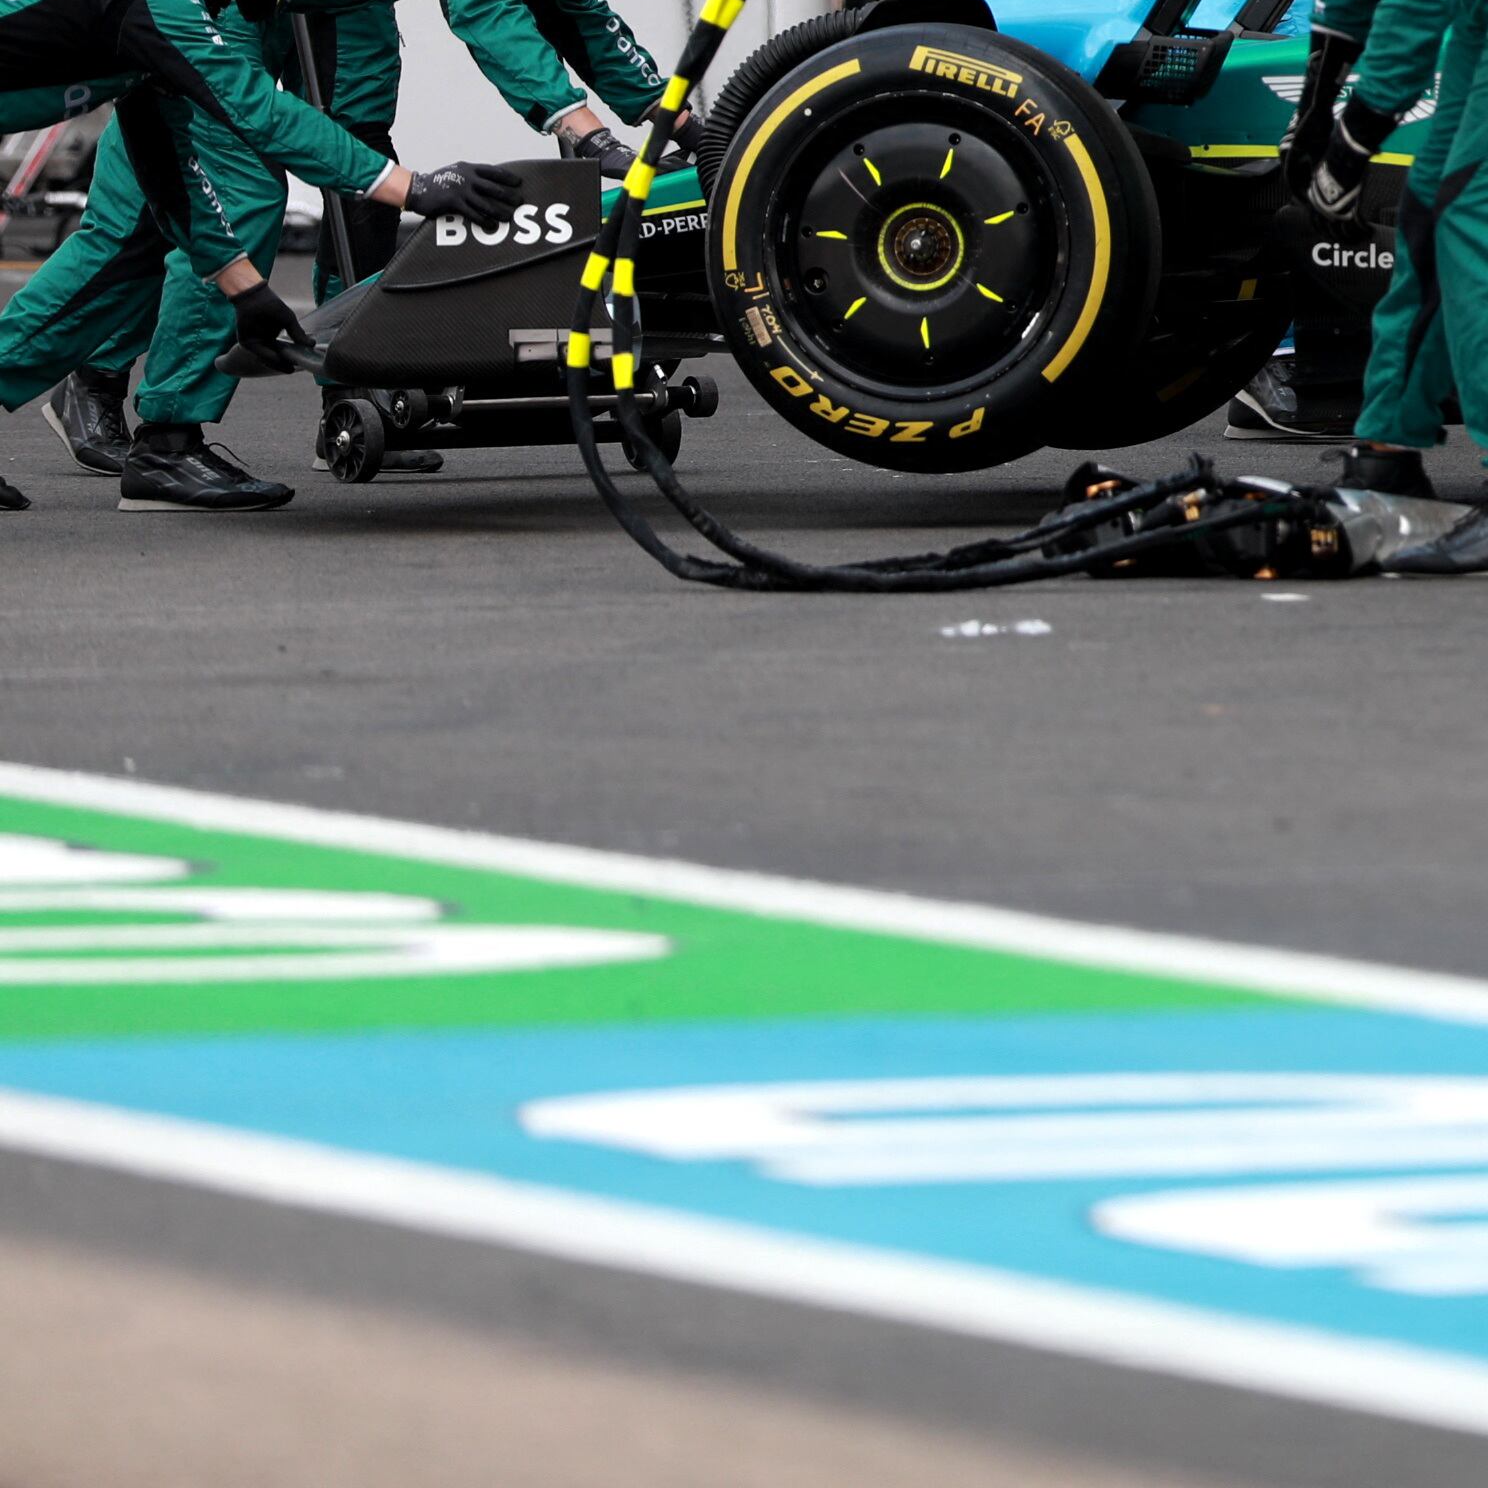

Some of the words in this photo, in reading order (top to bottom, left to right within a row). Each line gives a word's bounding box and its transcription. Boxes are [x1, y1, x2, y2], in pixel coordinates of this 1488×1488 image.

[909, 45, 1023, 99] PIRELLI
[1311, 242, 1395, 269] Circle
[769, 366, 934, 442] ZERO
[949, 407, 986, 439] P
